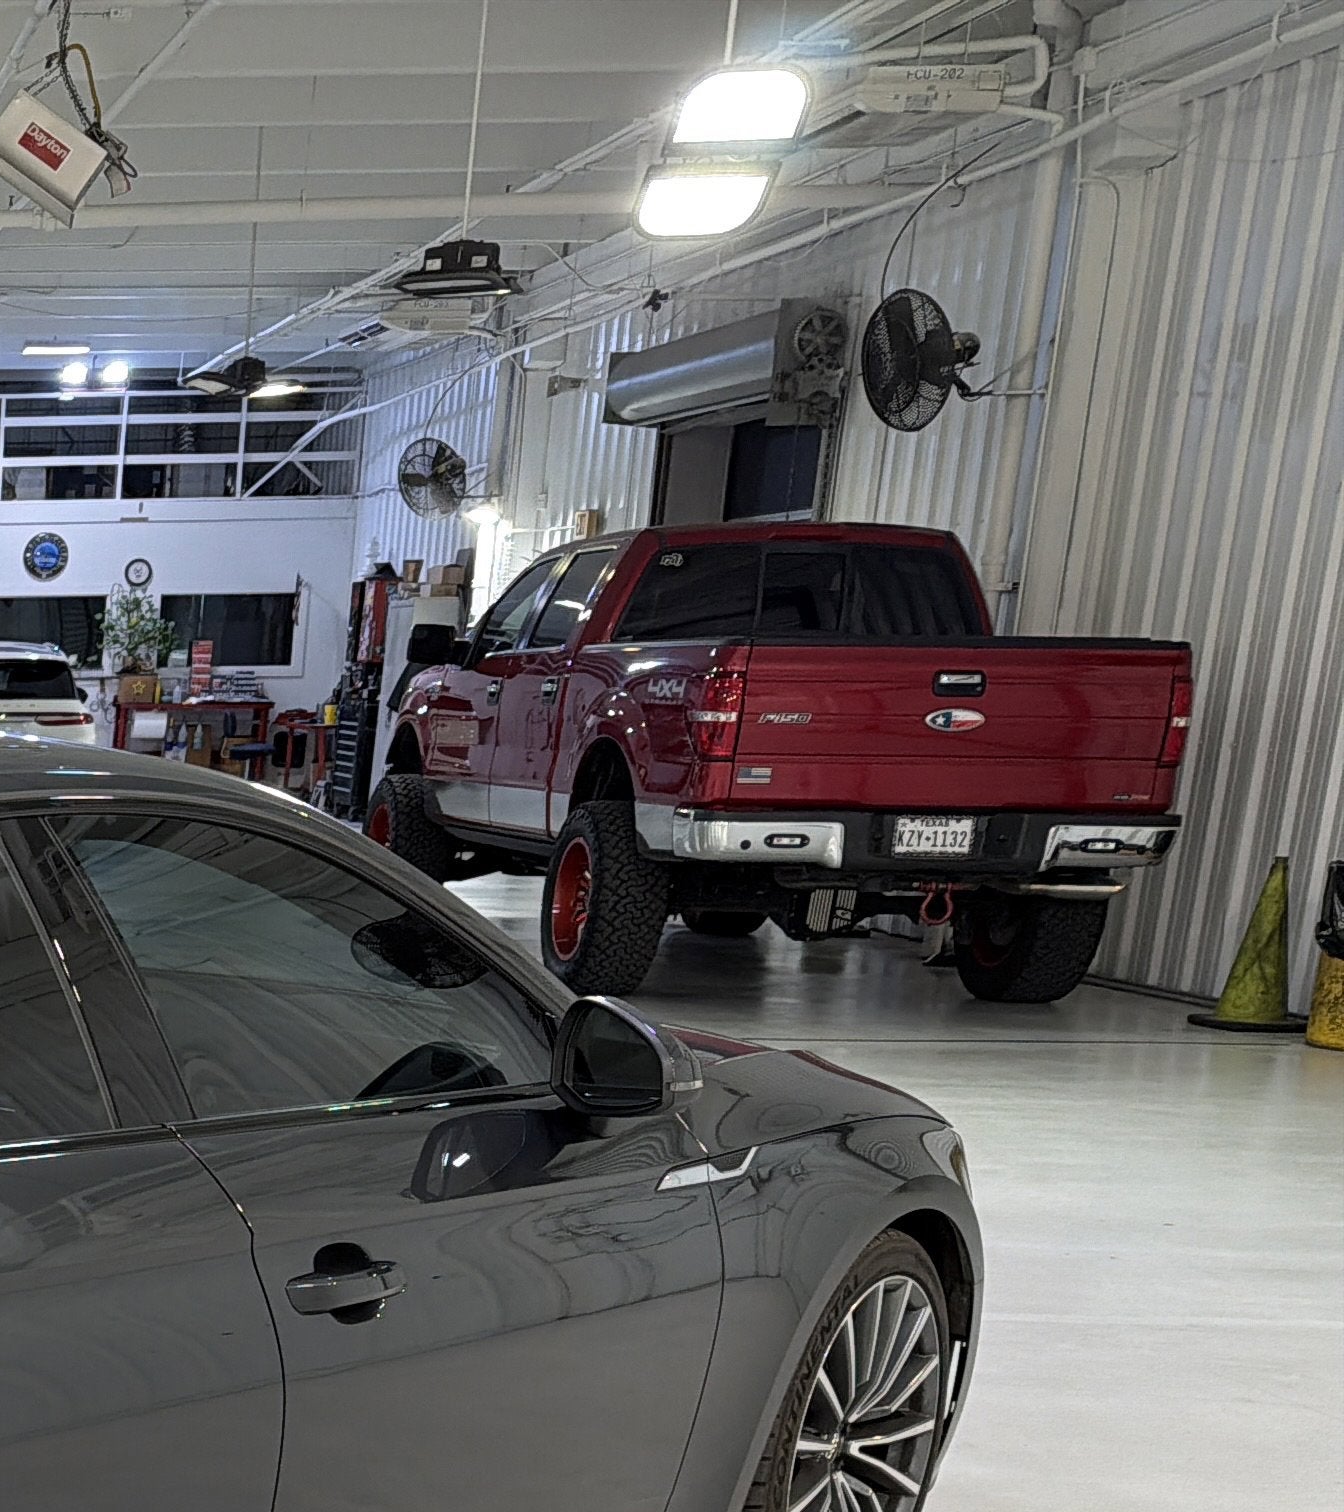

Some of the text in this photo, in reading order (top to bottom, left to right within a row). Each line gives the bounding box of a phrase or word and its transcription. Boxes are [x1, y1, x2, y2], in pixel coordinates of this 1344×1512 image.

[26, 124, 68, 159] Dayton
[648, 678, 687, 698] 4X4
[920, 819, 950, 828] TEXAS
